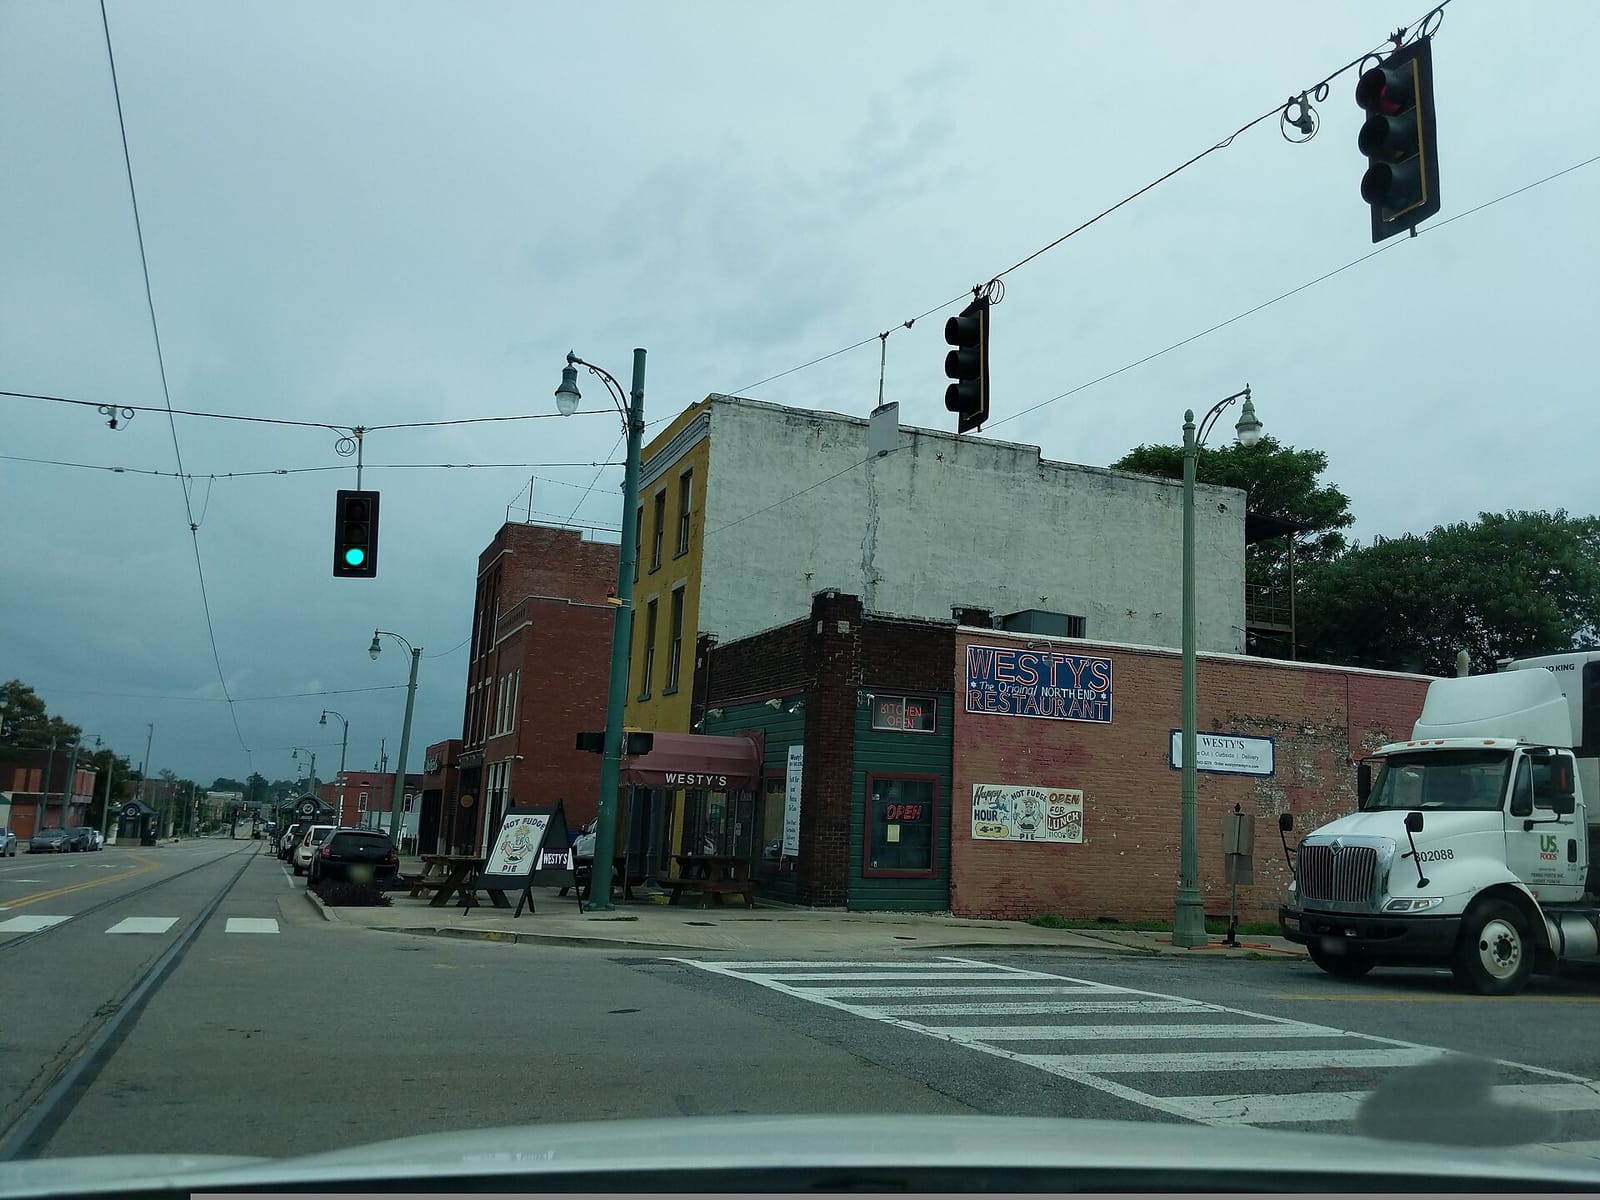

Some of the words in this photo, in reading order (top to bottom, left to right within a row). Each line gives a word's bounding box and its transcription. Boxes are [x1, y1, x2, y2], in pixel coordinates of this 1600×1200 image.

[968, 648, 1110, 692] WESTY'S
[1556, 663, 1575, 672] KING
[979, 681, 995, 692] The
[998, 681, 1039, 697] Original
[1041, 686, 1076, 699] NORTH
[1078, 689, 1097, 701] END
[880, 703, 922, 717] KITCHEN
[968, 689, 1108, 720] RESTAURANT
[887, 715, 914, 728] OPEN
[1202, 737, 1245, 749] WESTY'S
[1241, 753, 1259, 761] Delivery
[665, 772, 727, 786] WESTY'S
[973, 785, 1002, 806] Happy
[1011, 789, 1025, 801] HOT
[1027, 789, 1048, 802] FUDGE
[1049, 793, 1080, 804] OPEN
[887, 803, 922, 821] OPEN
[974, 809, 998, 821] HOUR
[1050, 806, 1065, 814] FOR
[504, 817, 520, 831] HOT
[522, 817, 546, 830] FUDGE
[1048, 812, 1079, 830] LUNCH
[543, 853, 568, 865] WESTY'S
